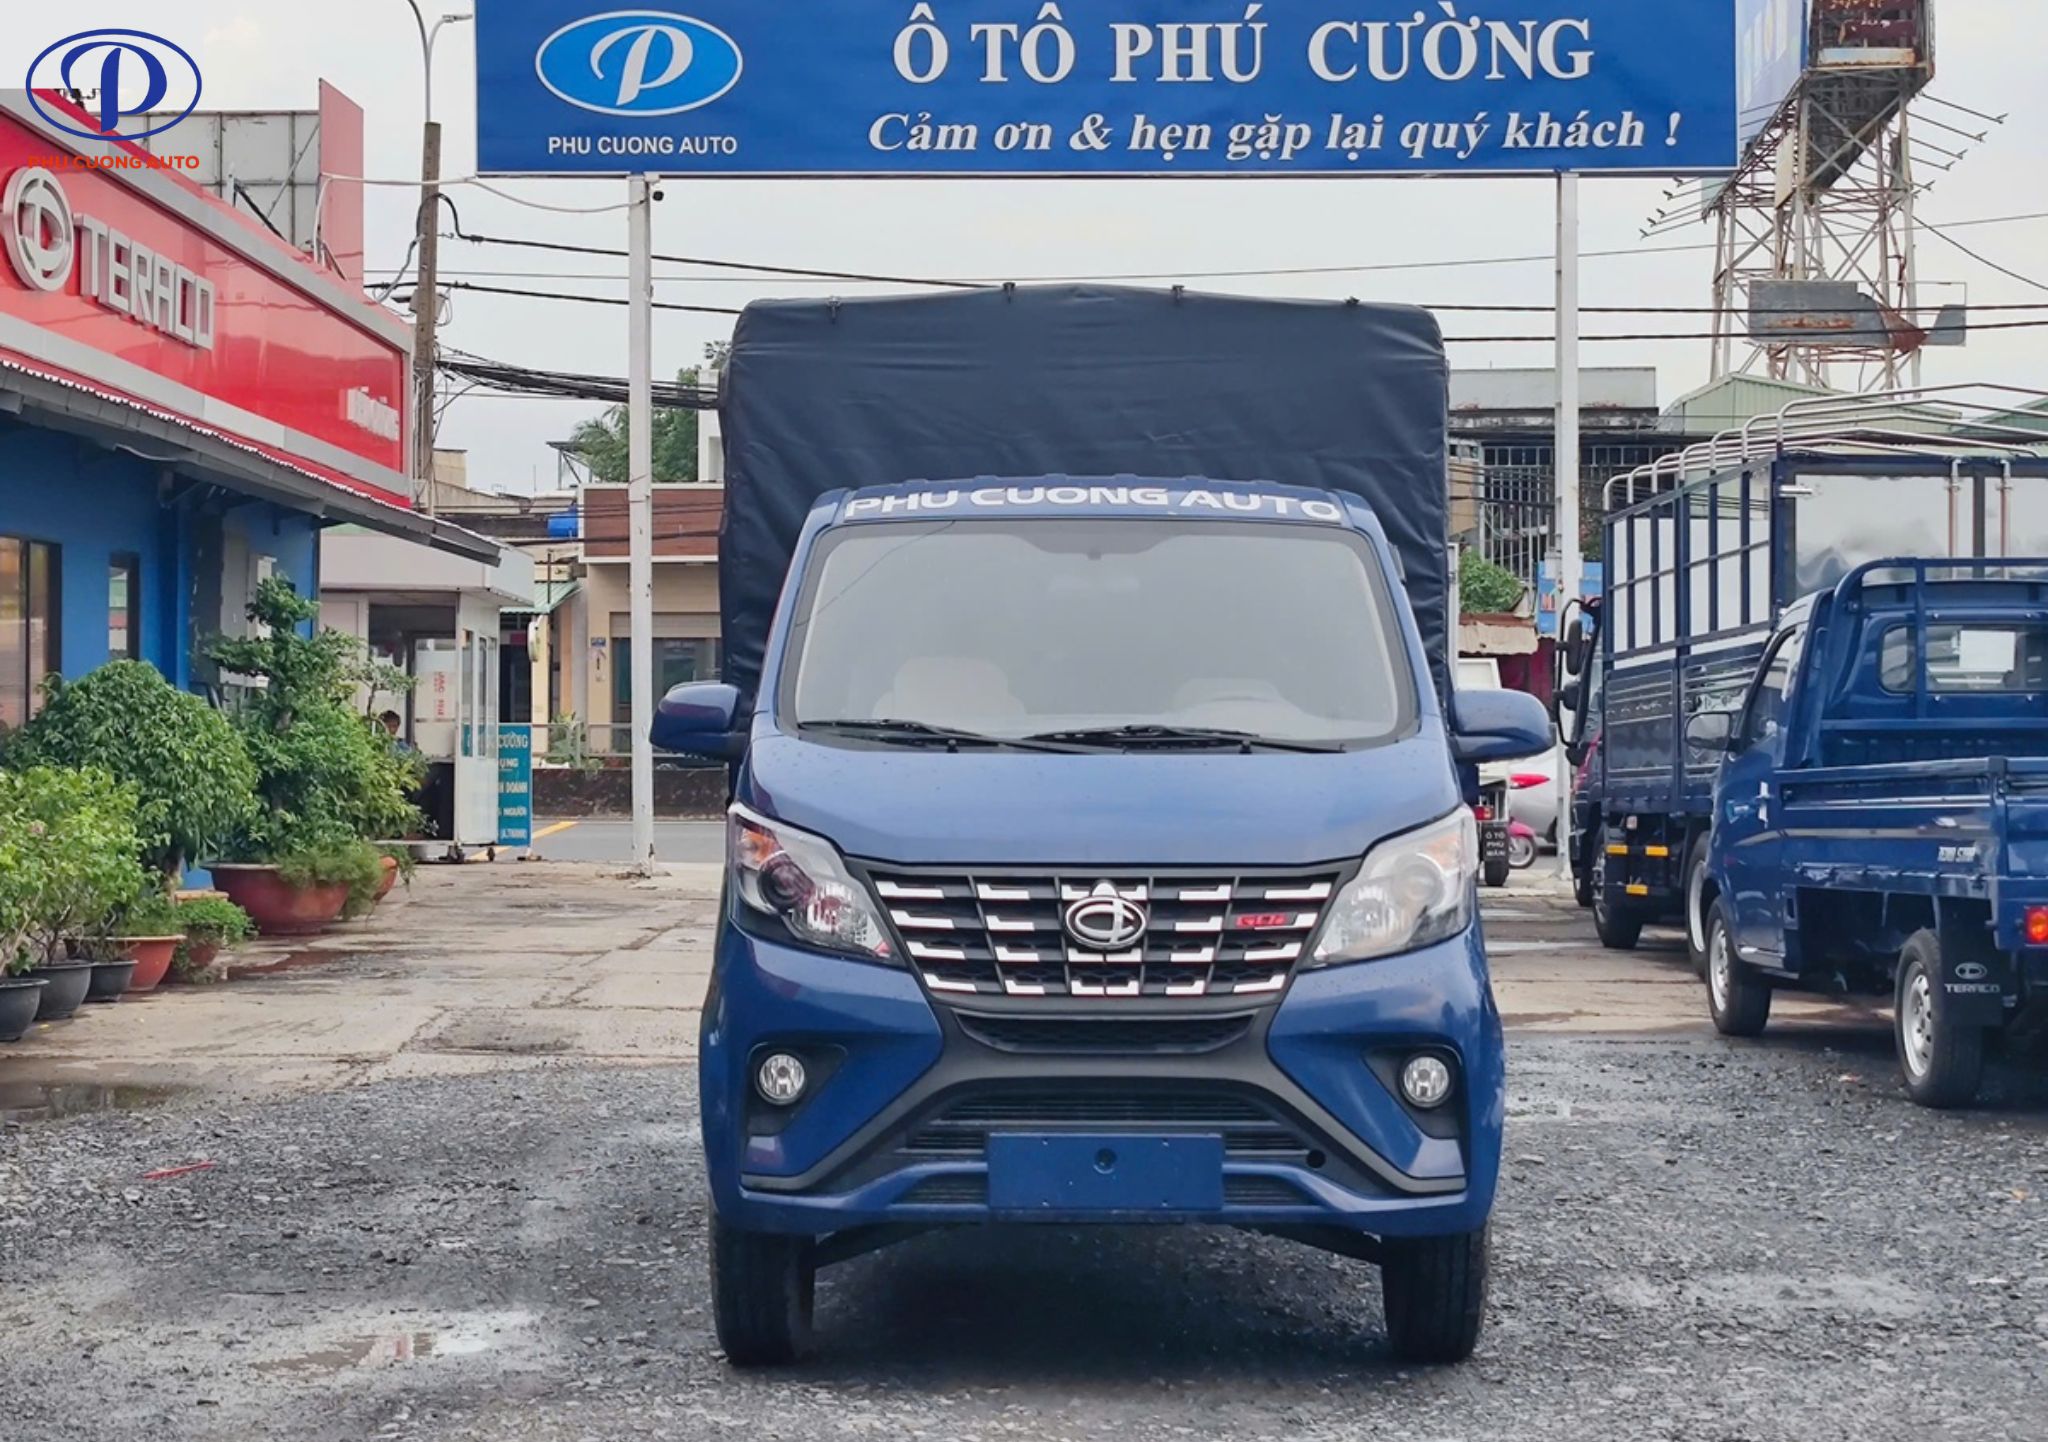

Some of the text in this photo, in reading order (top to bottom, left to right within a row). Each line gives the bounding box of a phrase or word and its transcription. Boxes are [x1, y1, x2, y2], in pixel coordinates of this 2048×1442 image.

[892, 0, 1595, 84] Ô TÔ PHÚ CƯỜNG
[548, 136, 738, 156] PHU CUONG AUTO
[868, 110, 1681, 161] Cảm ơn & hẹn gặp lại quý khách !
[845, 486, 1343, 521] PHU CUONG AUTO
